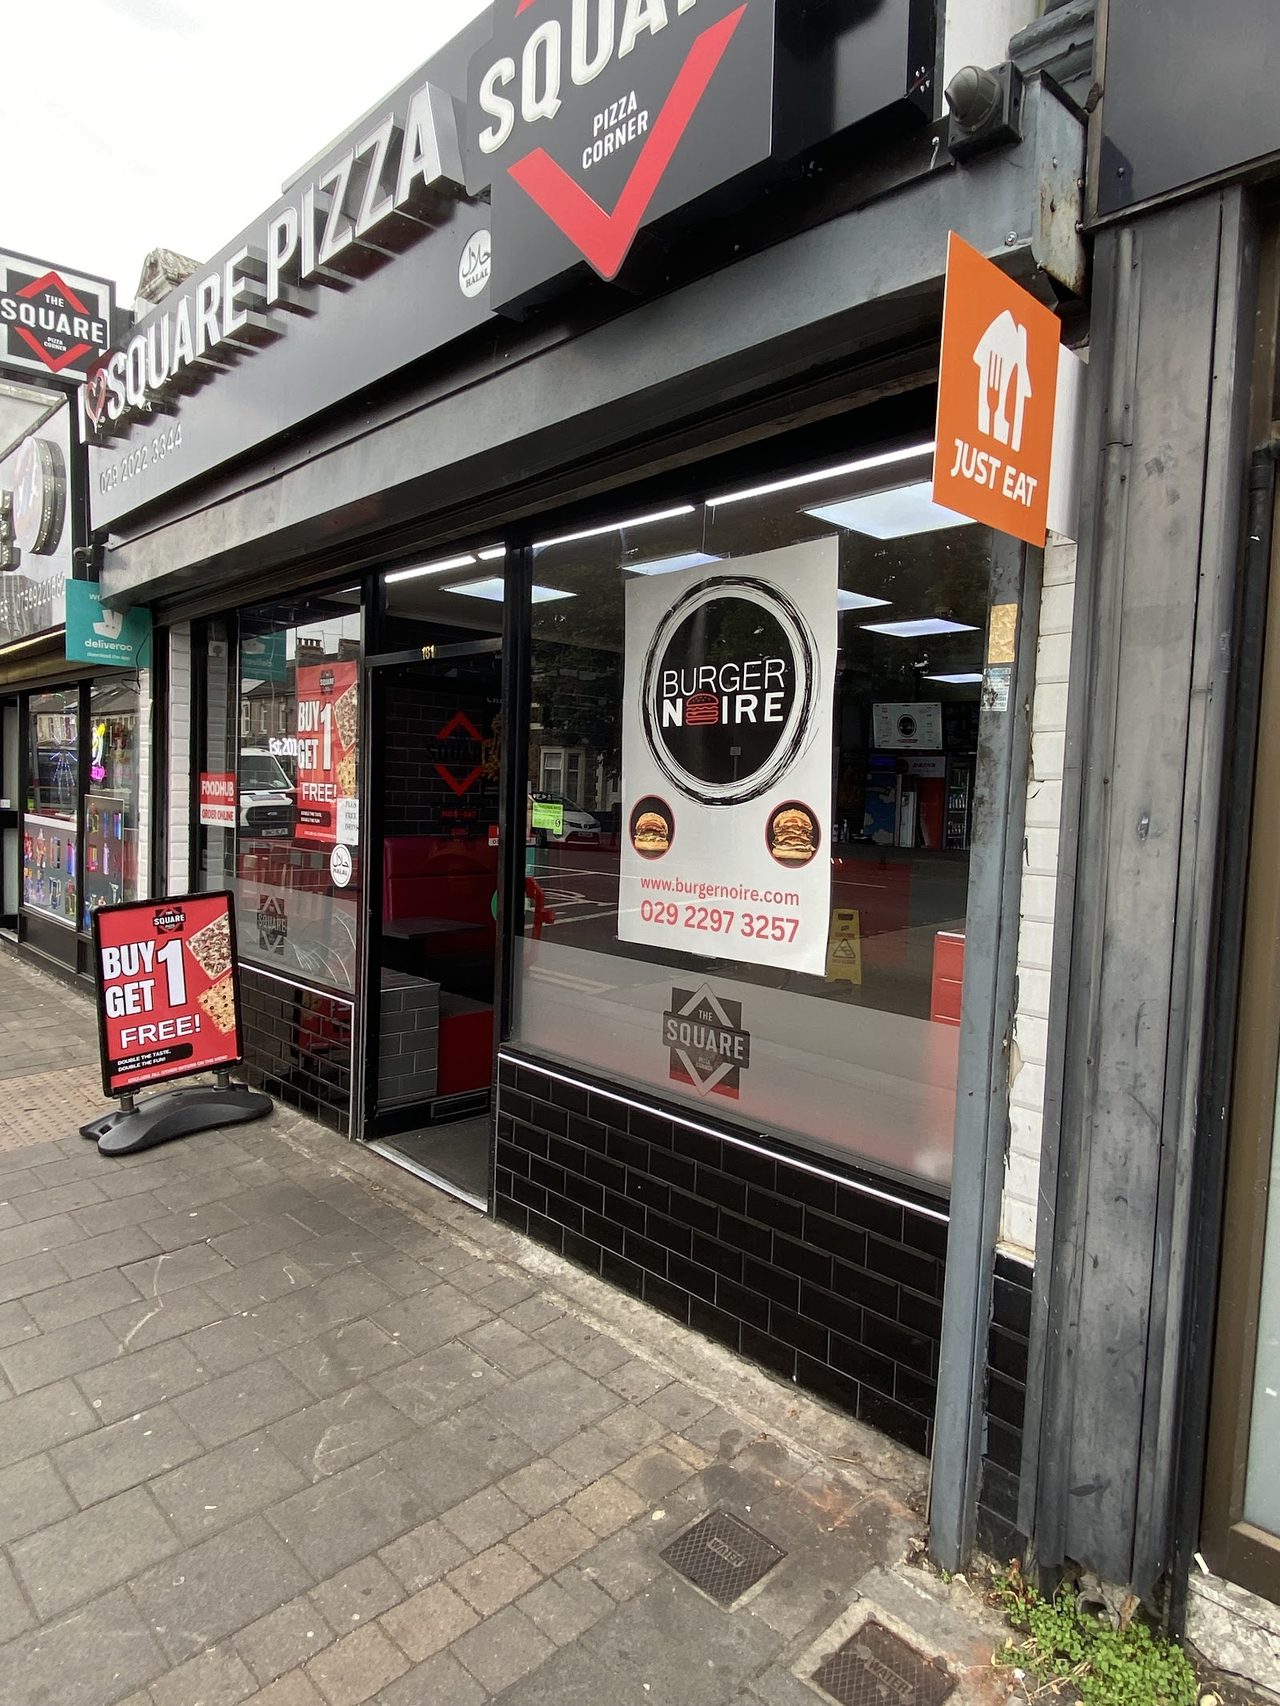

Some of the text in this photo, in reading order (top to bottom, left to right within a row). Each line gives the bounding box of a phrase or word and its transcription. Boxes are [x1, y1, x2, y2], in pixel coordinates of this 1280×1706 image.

[592, 90, 638, 137] PIZZA
[582, 110, 649, 170] CORNER
[106, 245, 249, 420] SQUARE
[266, 81, 446, 306] PIZZA
[465, 267, 489, 288] HALAL
[45, 294, 64, 308] THE
[0, 298, 104, 344] SQUARE
[99, 422, 183, 495] 029 2022 3344
[950, 438, 1038, 508] JUST EAT
[84, 638, 133, 652] deliveroo
[421, 644, 435, 660] 181
[663, 658, 786, 698] BURGER
[298, 700, 332, 770] BUY 1
[298, 738, 319, 770] GET
[201, 780, 234, 797] FOODHUB
[302, 782, 337, 803] FREE!
[640, 877, 800, 906] www.burgernoire.com
[153, 913, 185, 926] SQUARE
[640, 899, 800, 943] 029 2297 3257
[102, 938, 187, 1007] BUY 1
[105, 979, 156, 1019] GET
[698, 1009, 713, 1022] THE
[120, 1014, 201, 1049] FREE!
[666, 1019, 745, 1060] SQUARE
[117, 1055, 141, 1066] DOUBLE
[141, 1053, 152, 1061] THE
[118, 1062, 141, 1073] DOUBLE
[709, 1538, 746, 1567] WATER
[867, 1659, 912, 1694] WATER
